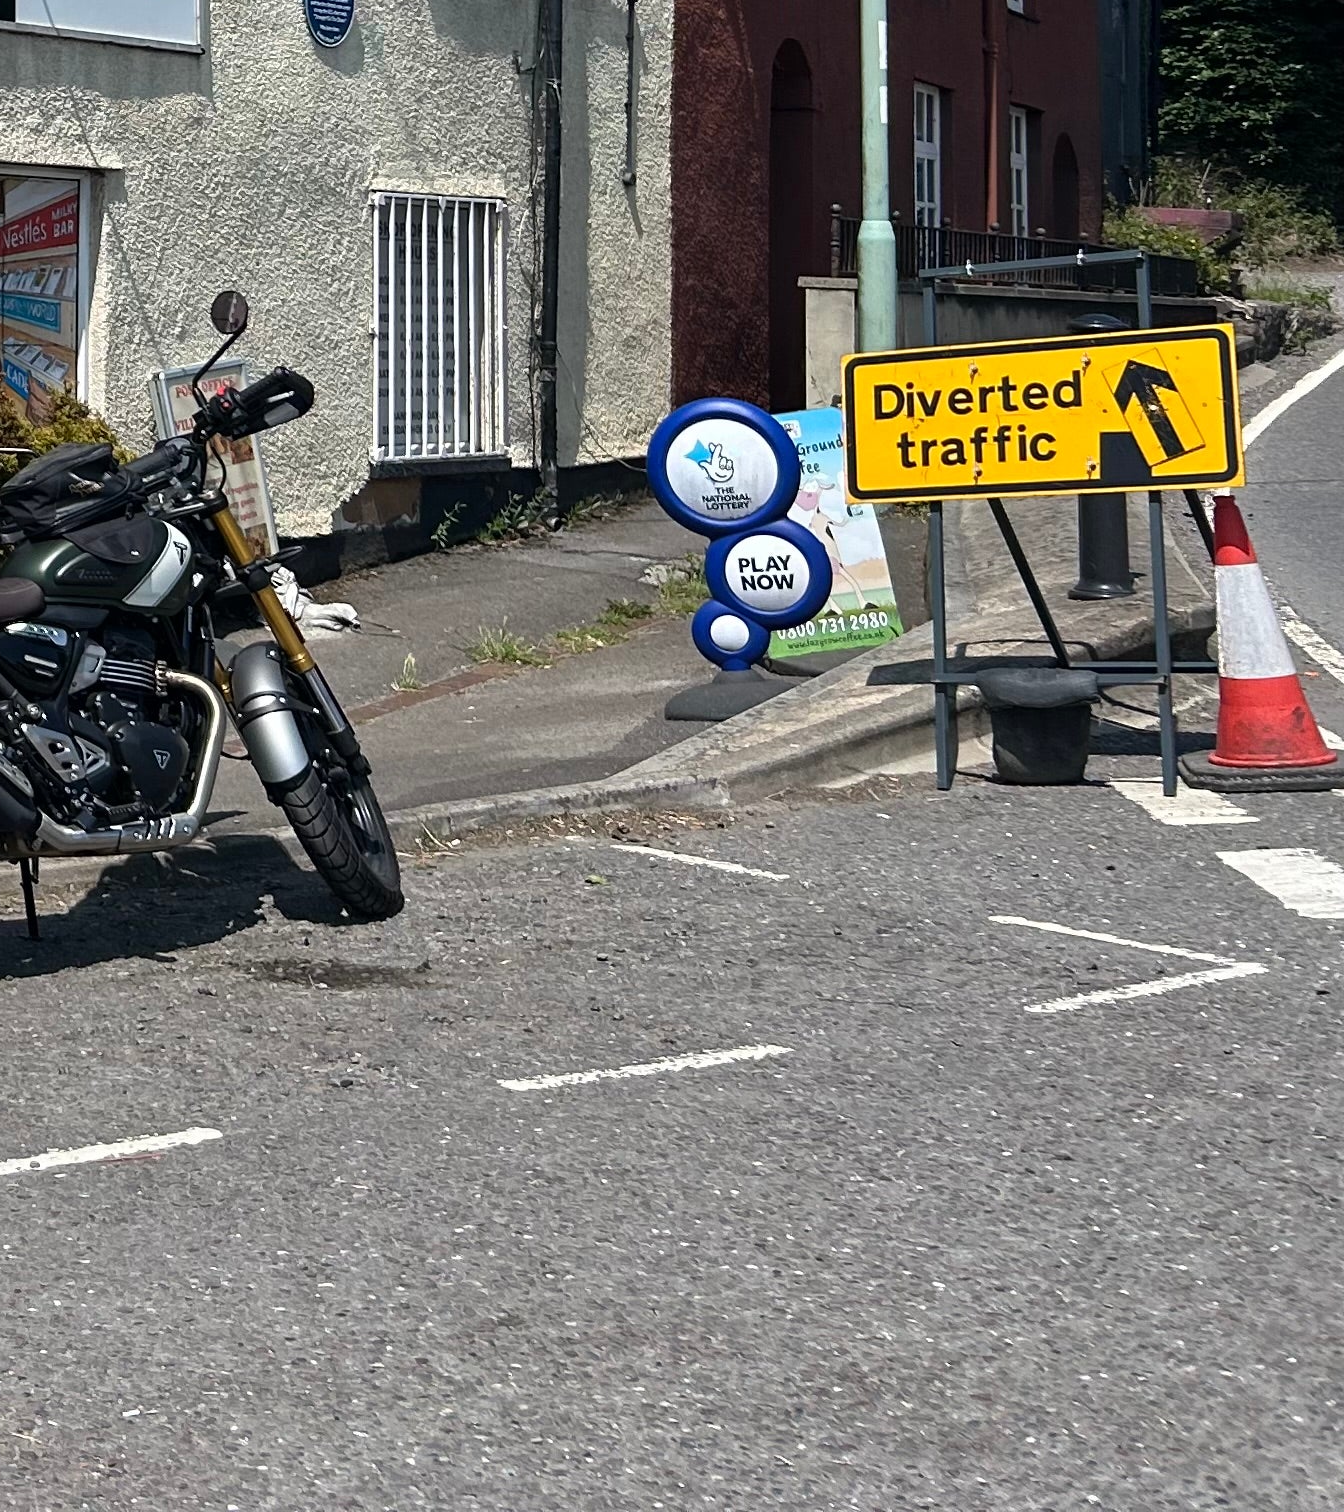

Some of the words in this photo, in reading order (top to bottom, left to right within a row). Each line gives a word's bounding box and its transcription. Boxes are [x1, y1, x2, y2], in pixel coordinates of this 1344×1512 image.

[53, 219, 74, 238] BAR
[873, 370, 1083, 421] Diverted
[796, 434, 844, 456] Ground
[896, 424, 1057, 469] traffic
[701, 494, 751, 502] NATIONAL
[714, 486, 735, 494] THE
[705, 500, 750, 510] LOTTERY
[738, 554, 792, 573] PLAY
[740, 574, 795, 592] NOW
[776, 620, 816, 640] 0800
[818, 616, 846, 635] 731
[849, 611, 888, 630] 2980
